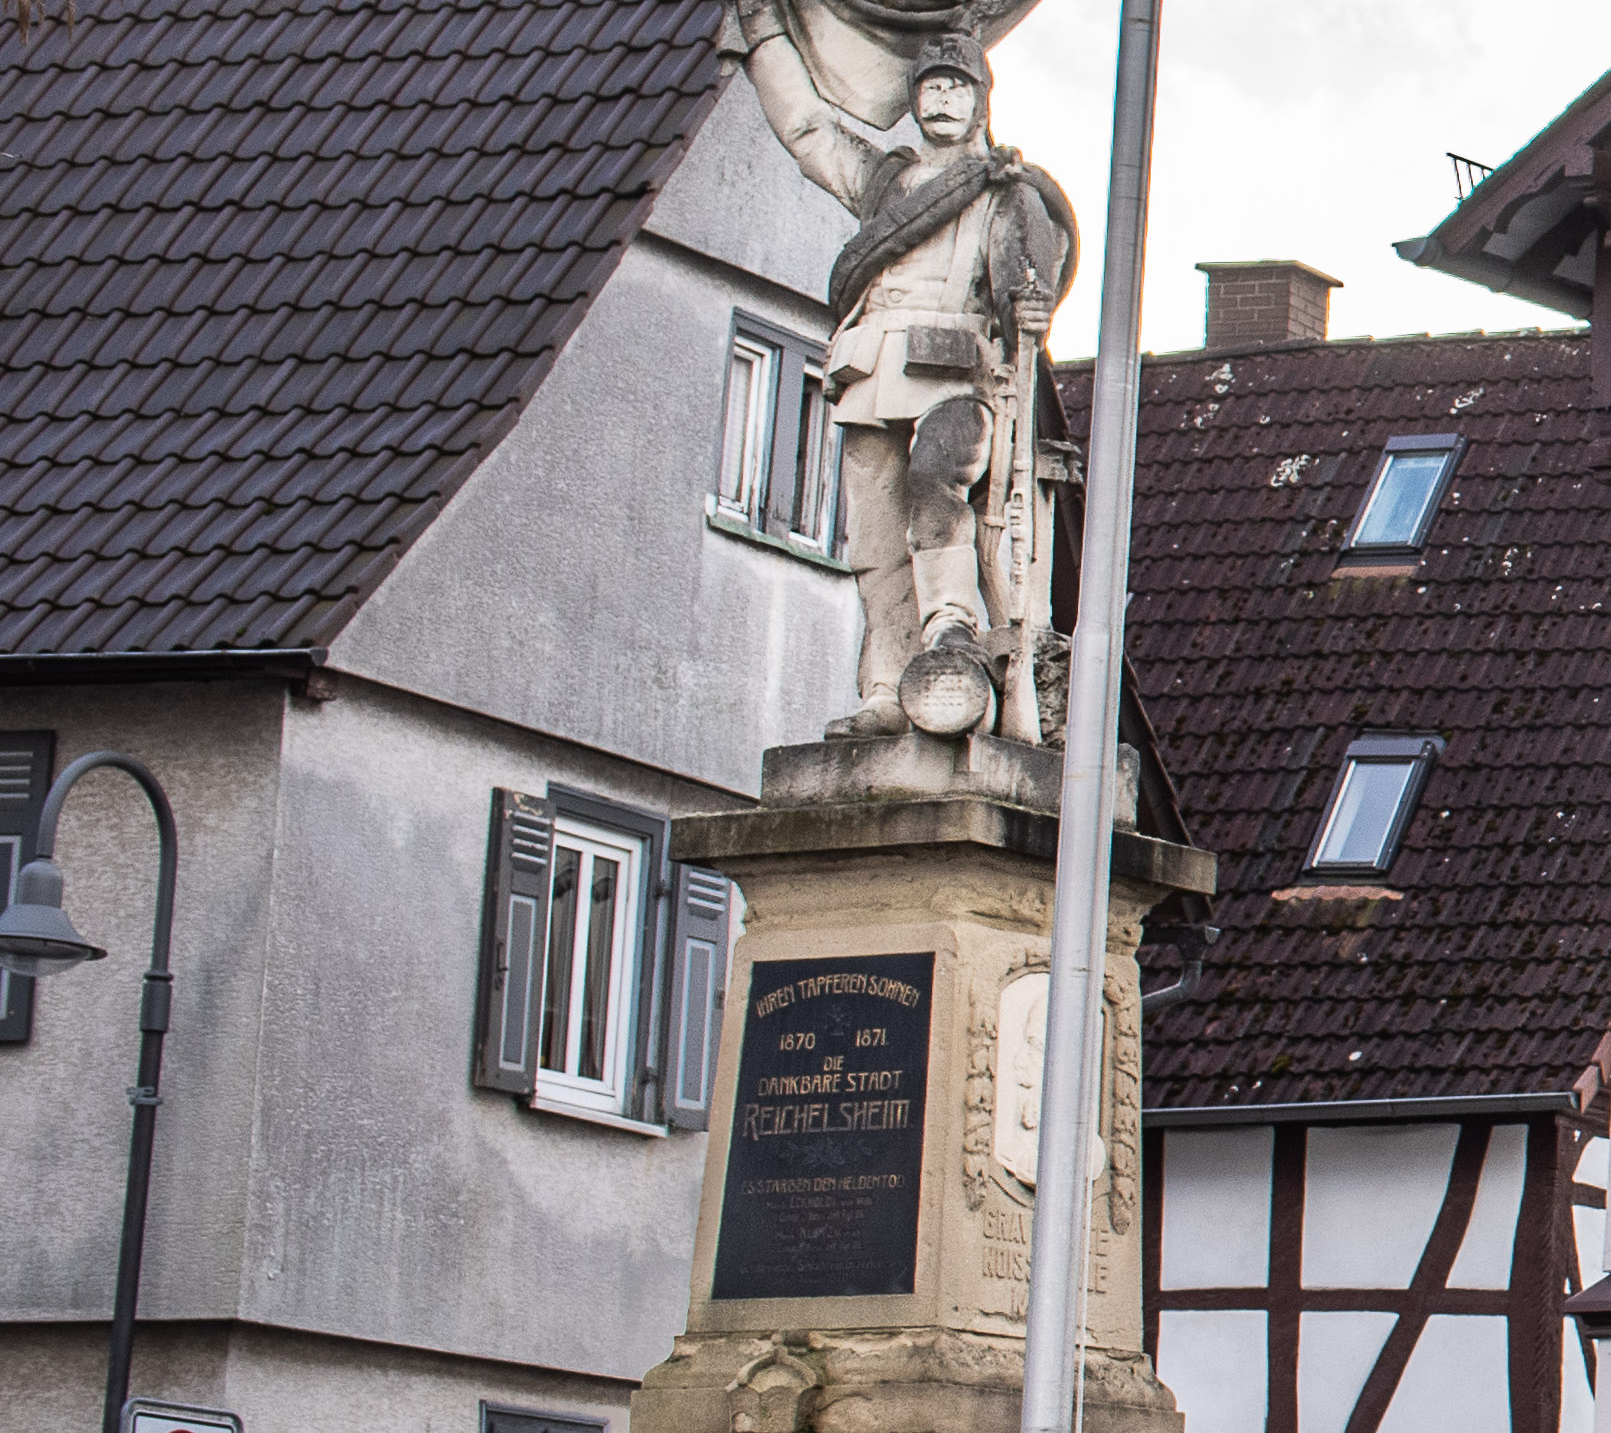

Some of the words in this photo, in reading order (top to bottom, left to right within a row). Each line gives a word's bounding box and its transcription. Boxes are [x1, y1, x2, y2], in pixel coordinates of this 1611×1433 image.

[798, 973, 867, 1000] TAPFEREN
[779, 1032, 816, 1051] 1870
[823, 1055, 844, 1071] DIE
[758, 1074, 842, 1096] DANKBARE
[845, 1070, 902, 1092] STADT
